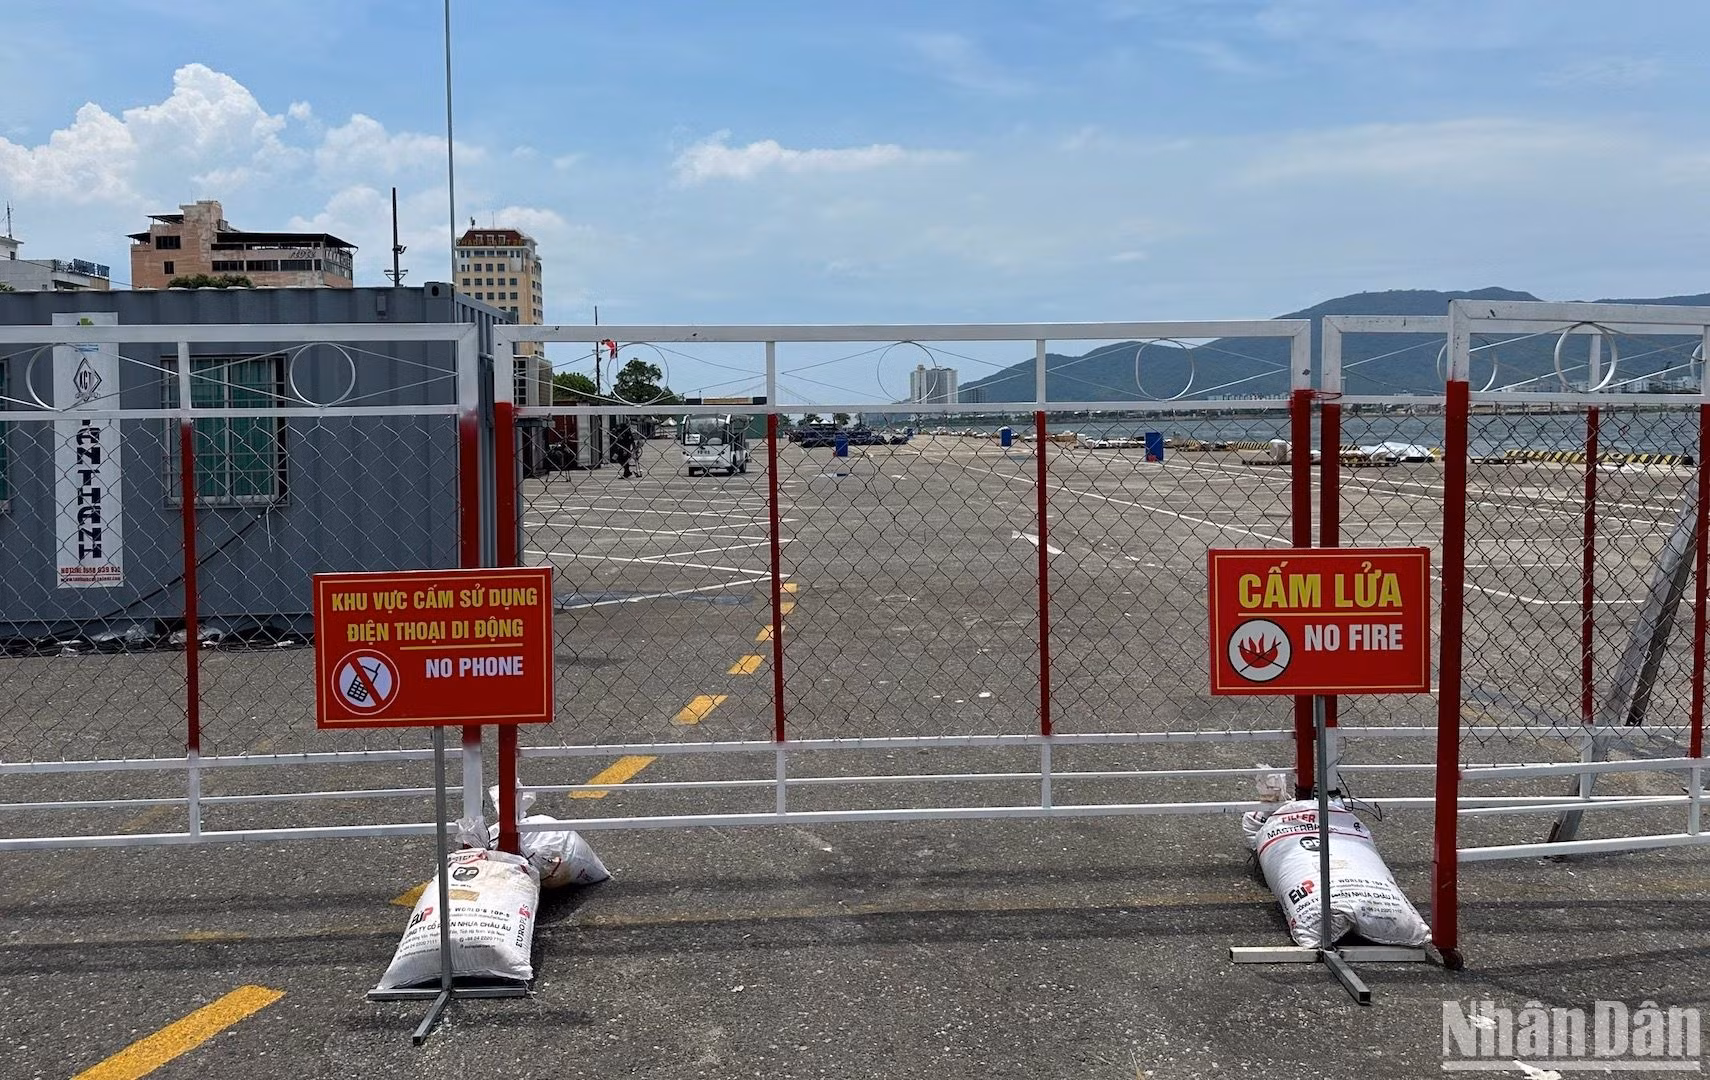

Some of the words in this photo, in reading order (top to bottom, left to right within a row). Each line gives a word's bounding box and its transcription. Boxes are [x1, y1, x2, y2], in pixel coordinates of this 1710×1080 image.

[332, 592, 368, 611] KHU
[373, 589, 408, 614] VỰC
[414, 585, 454, 609] CẤM
[460, 583, 485, 608] SỬ
[489, 588, 537, 610] DỤNG
[1238, 561, 1321, 609] CẤM
[1334, 561, 1403, 608] LỬA
[347, 620, 389, 645] ĐIỆN
[396, 621, 445, 644] THOẠI
[452, 620, 469, 639] DI
[474, 616, 523, 642] ĐỘNG
[1304, 624, 1341, 652] NO
[1348, 624, 1403, 651] FIRE
[425, 658, 452, 678] NO
[459, 655, 524, 677] PHONE
